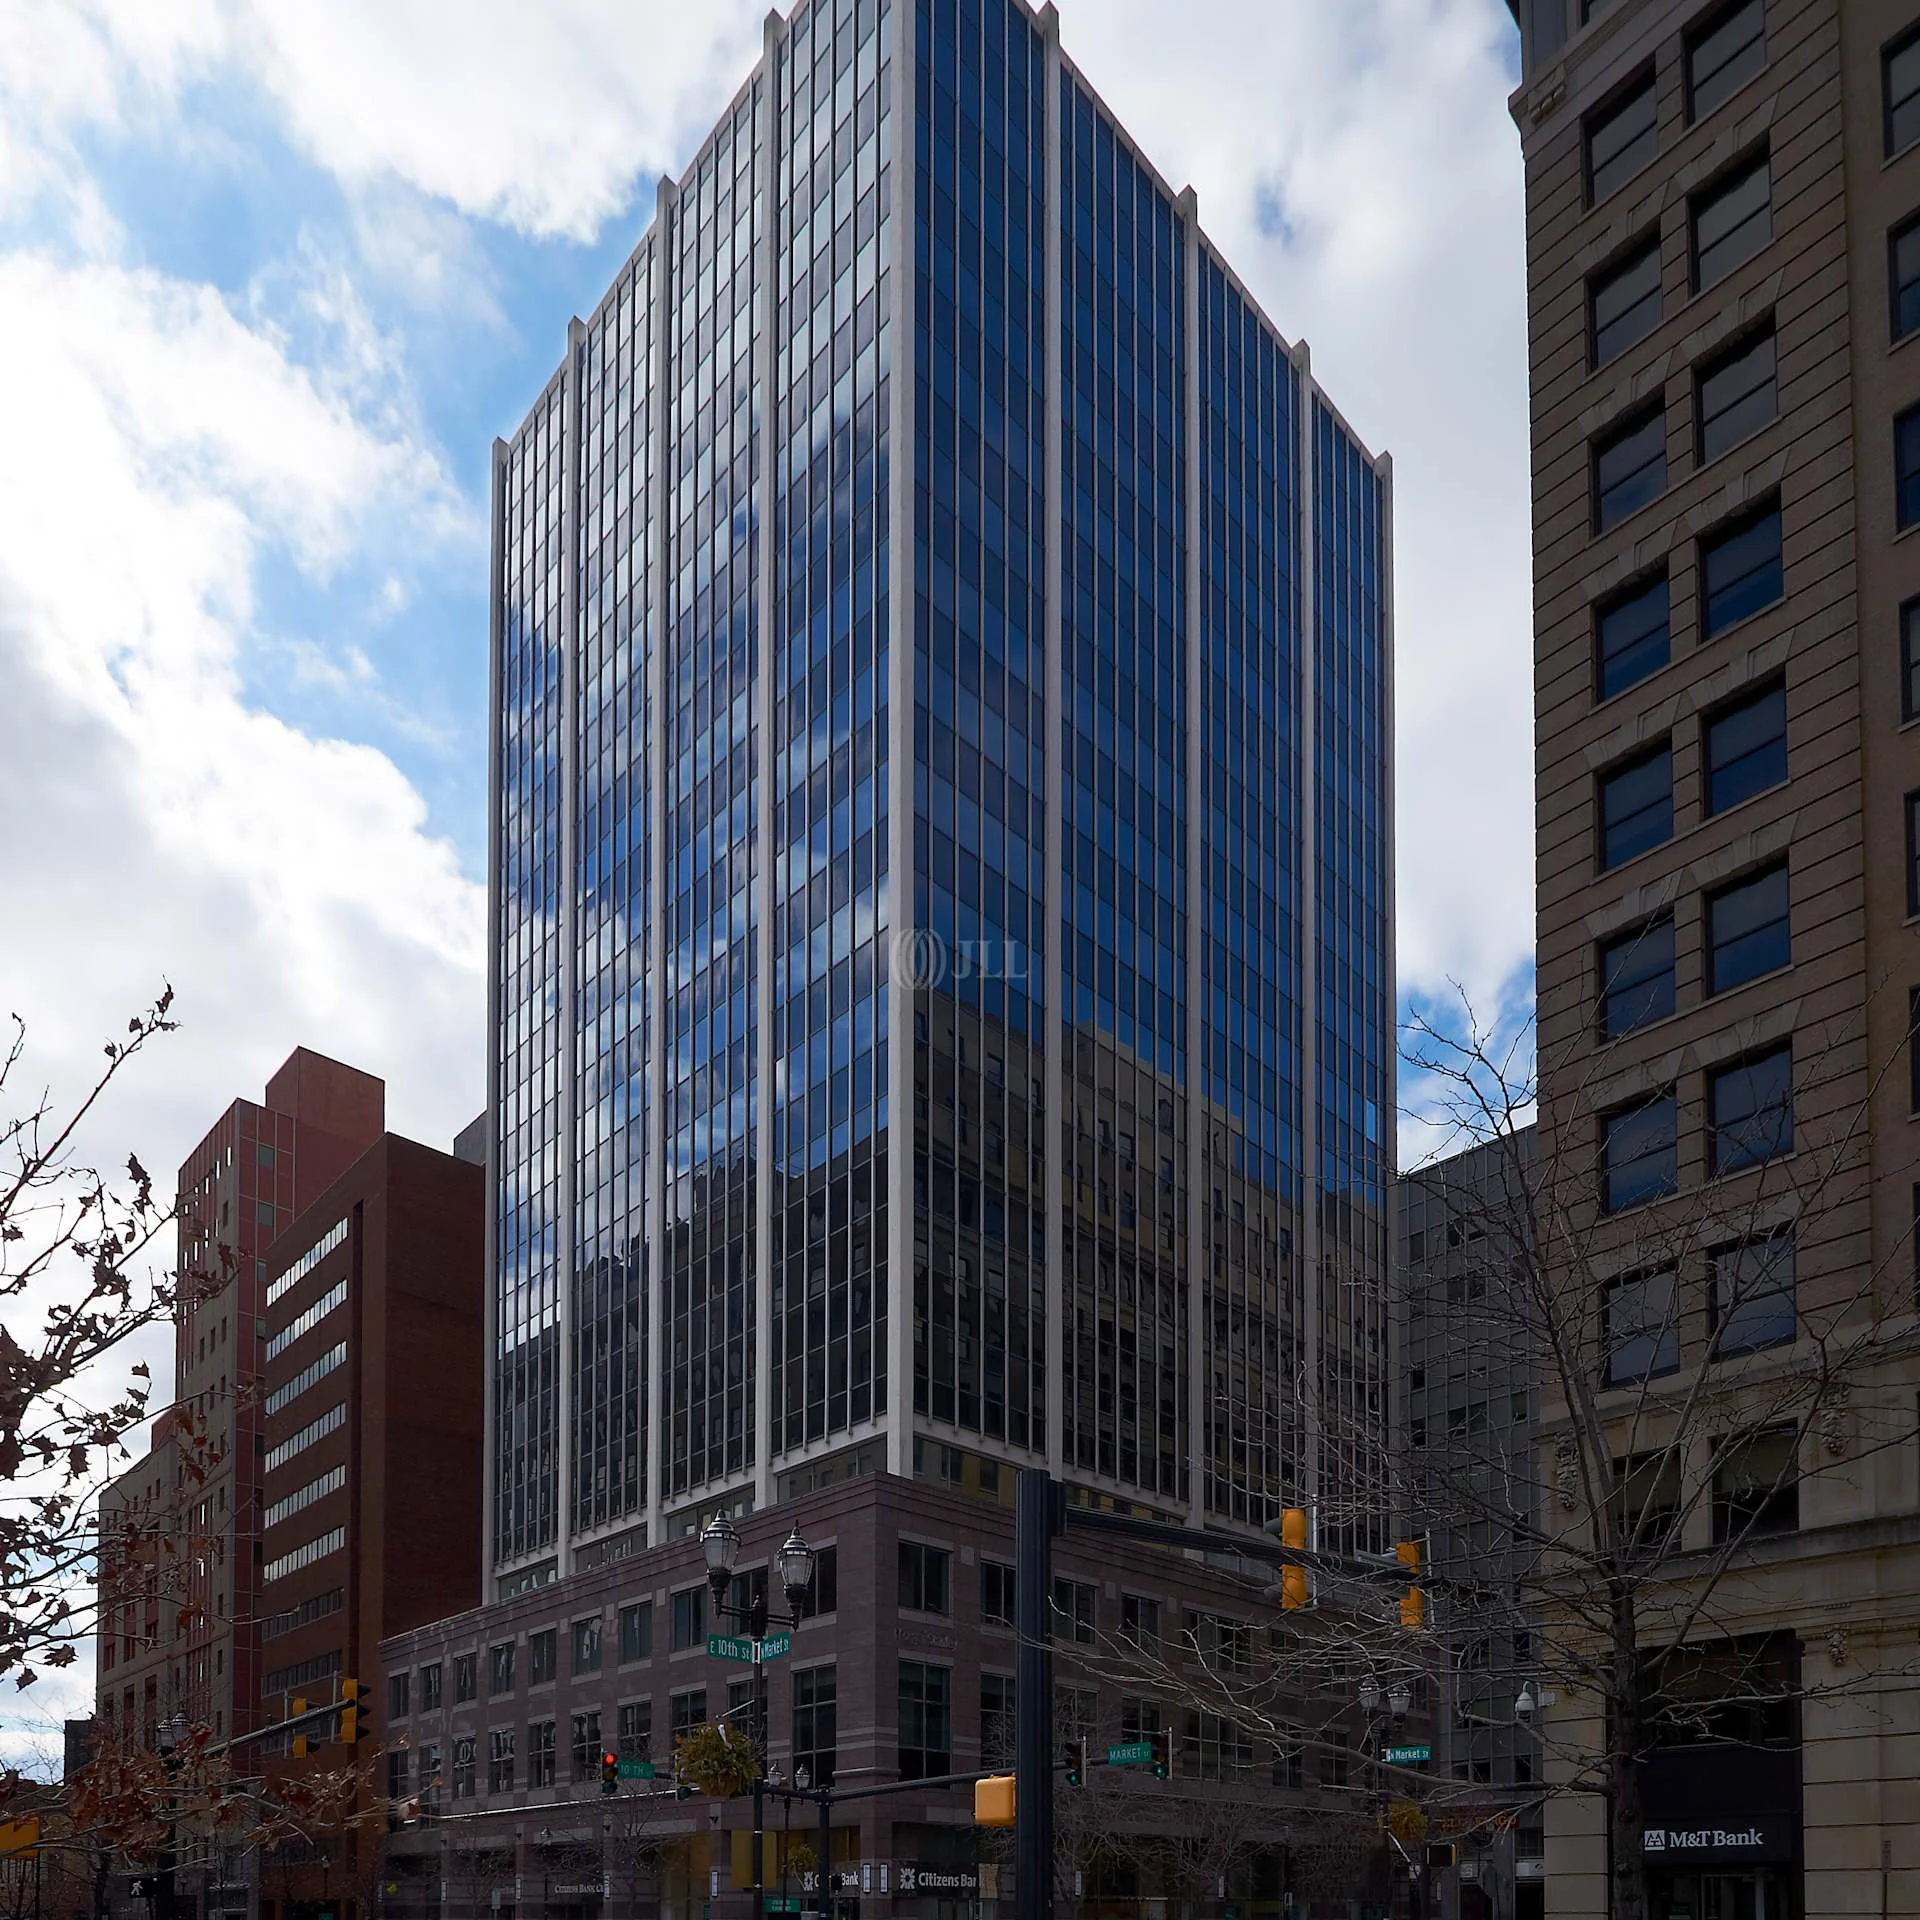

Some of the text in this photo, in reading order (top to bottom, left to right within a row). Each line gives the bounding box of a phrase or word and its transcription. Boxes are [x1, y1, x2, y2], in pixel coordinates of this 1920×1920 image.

[710, 1640, 714, 1653] E
[718, 1639, 738, 1657] 10th
[765, 1636, 783, 1657] Market
[1110, 1747, 1141, 1761] MARKET
[1395, 1749, 1420, 1760] Market
[621, 1764, 630, 1775] 10
[1669, 1827, 1764, 1848] M&T Bank
[918, 1872, 960, 1888] Citizens
